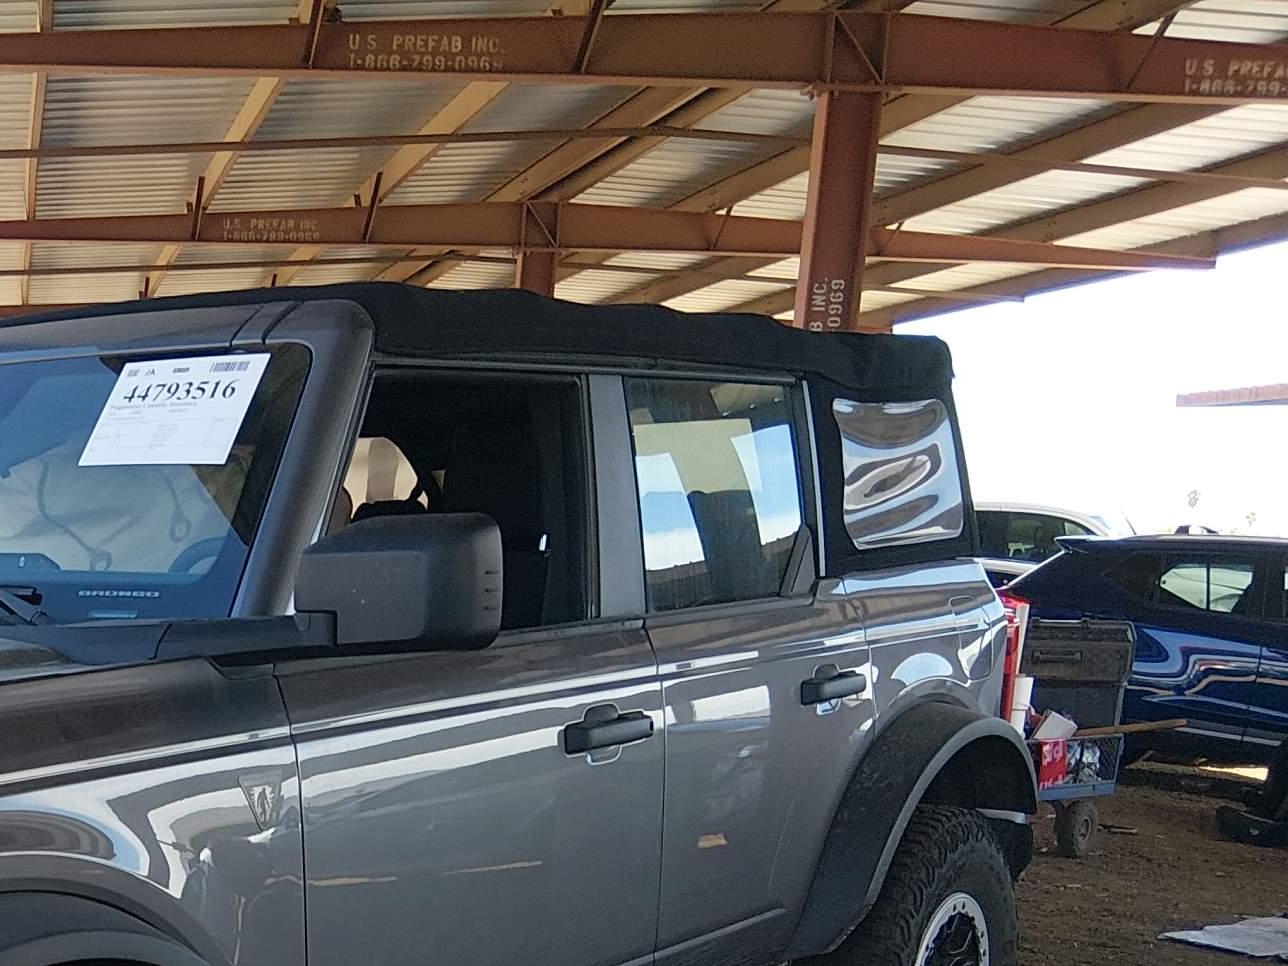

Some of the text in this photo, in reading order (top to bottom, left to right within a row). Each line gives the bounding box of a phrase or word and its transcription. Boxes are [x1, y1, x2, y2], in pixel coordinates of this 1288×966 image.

[392, 34, 462, 53] PREFAB
[471, 36, 505, 54] INC.
[1228, 61, 1288, 78] PREFA
[811, 277, 827, 312] INC.
[123, 378, 240, 403] 44793516
